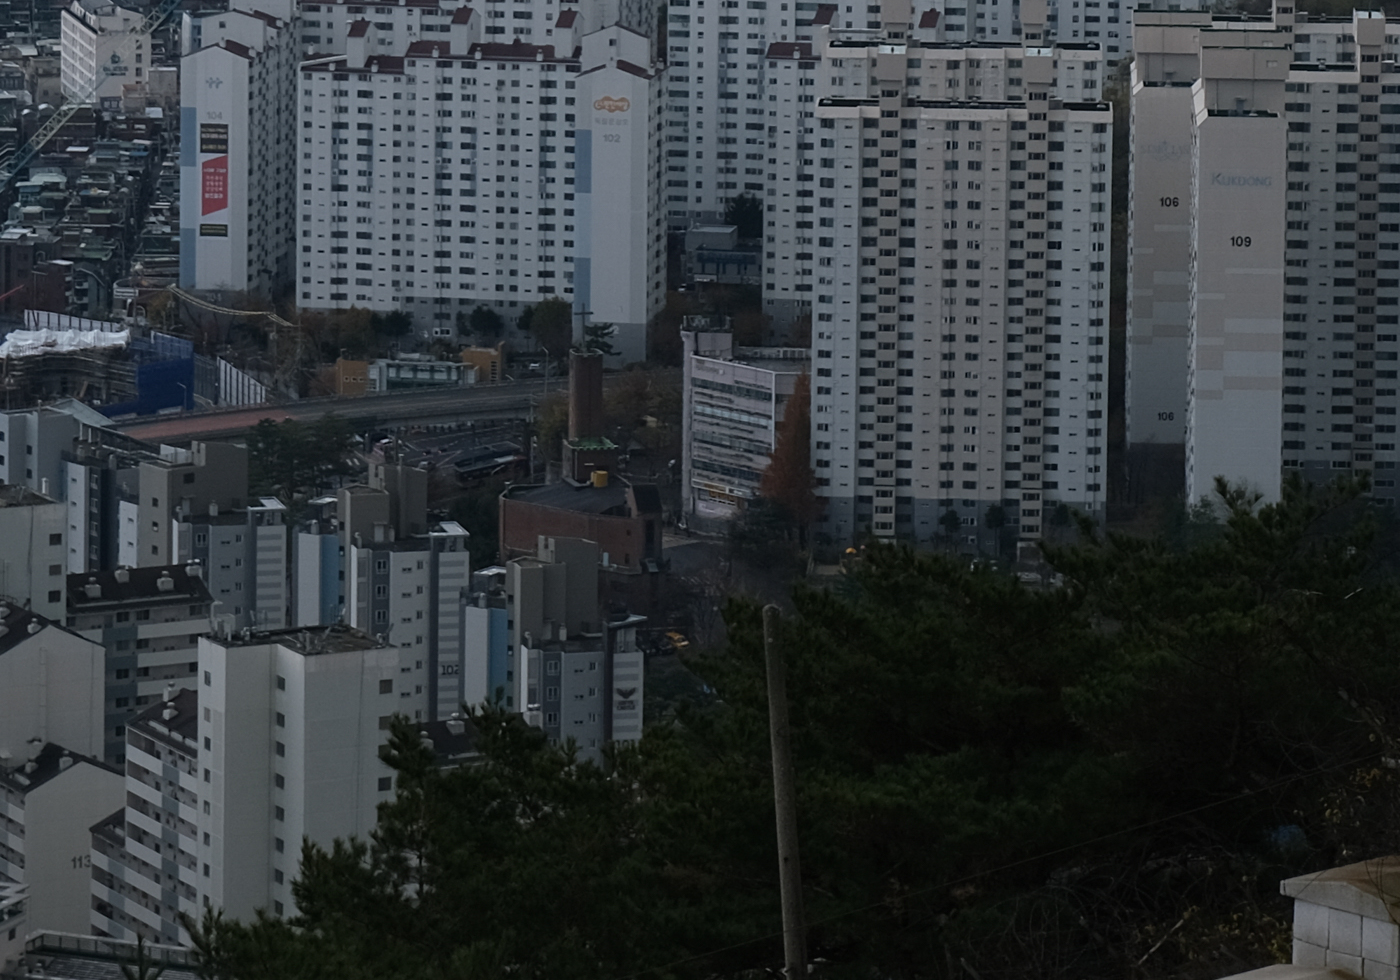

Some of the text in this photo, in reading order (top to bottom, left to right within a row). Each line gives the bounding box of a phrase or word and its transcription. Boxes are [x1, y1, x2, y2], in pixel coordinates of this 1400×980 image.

[206, 111, 222, 120] 104
[603, 133, 621, 143] 102
[1159, 196, 1180, 208] 106
[1230, 235, 1253, 248] 109
[1156, 411, 1175, 421] 106
[441, 664, 459, 676] 102
[71, 854, 91, 870] 113
